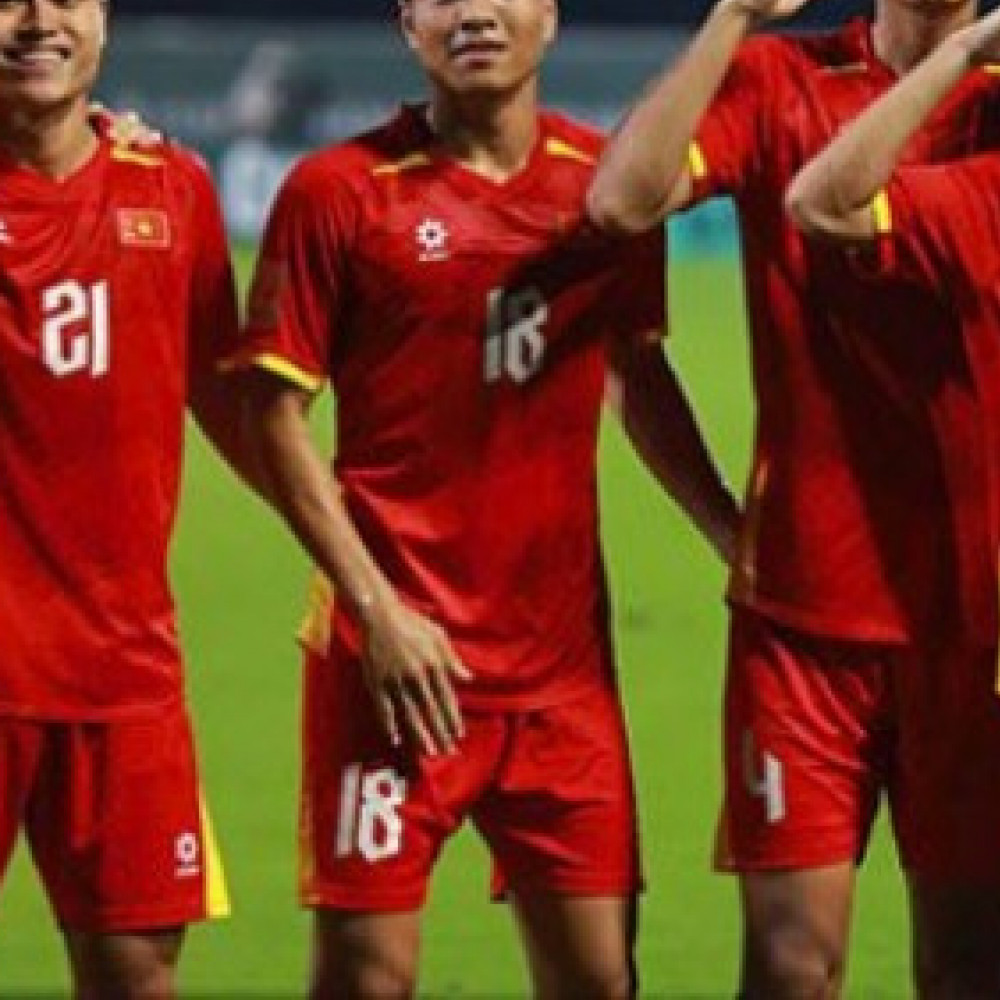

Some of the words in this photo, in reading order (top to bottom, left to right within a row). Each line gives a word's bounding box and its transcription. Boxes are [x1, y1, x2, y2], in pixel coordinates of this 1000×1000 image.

[41, 279, 109, 376] 21
[484, 288, 549, 383] 18
[335, 763, 407, 862] 18
[745, 727, 785, 823] 4
